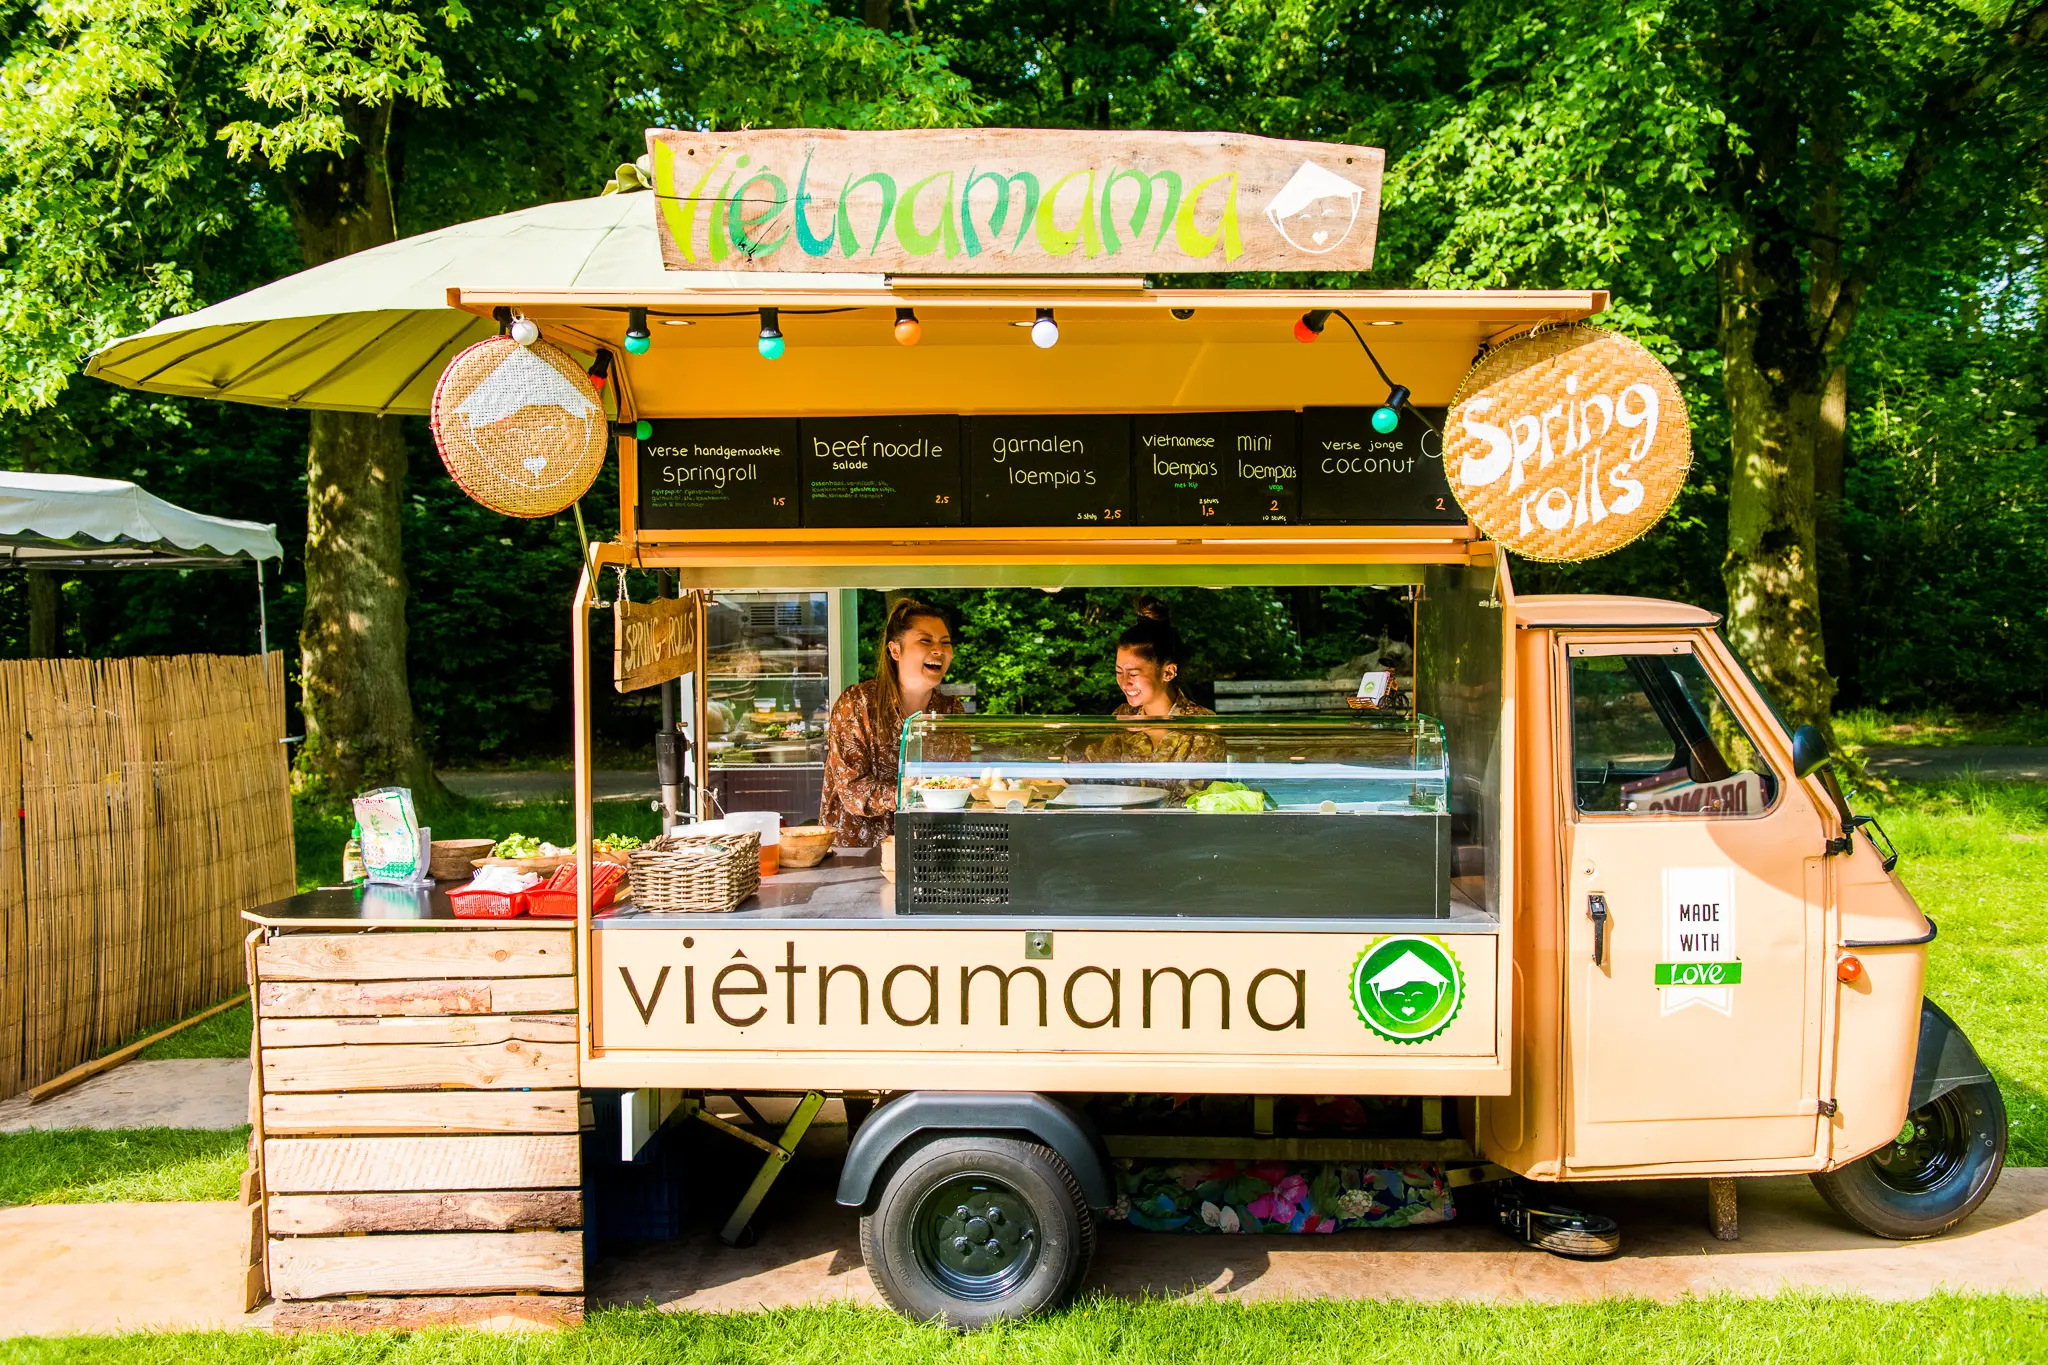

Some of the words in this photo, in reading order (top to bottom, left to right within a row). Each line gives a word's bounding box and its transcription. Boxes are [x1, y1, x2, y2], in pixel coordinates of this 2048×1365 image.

[1237, 434, 1272, 451] mini
[1460, 375, 1660, 496] Spring
[694, 445, 780, 459] handgemaakte
[813, 435, 869, 457] beef
[873, 438, 942, 457] noodle
[993, 435, 1084, 462] garnalen
[1368, 440, 1404, 453] jonge
[832, 460, 868, 470] salade
[1153, 453, 1218, 479] loempia's
[1238, 459, 1297, 483] loempia's
[1009, 466, 1096, 489] loempia's
[1268, 484, 1284, 492] vega
[1520, 447, 1645, 538] rolls
[773, 497, 786, 506] 1,5
[935, 495, 950, 504] 2,5
[1270, 499, 1279, 511] 2
[1435, 498, 1446, 511] 2
[1103, 508, 1122, 520] 2,5
[1202, 504, 1215, 517] 1,5
[1680, 903, 1720, 922] MADE
[1680, 933, 1719, 952] WITH
